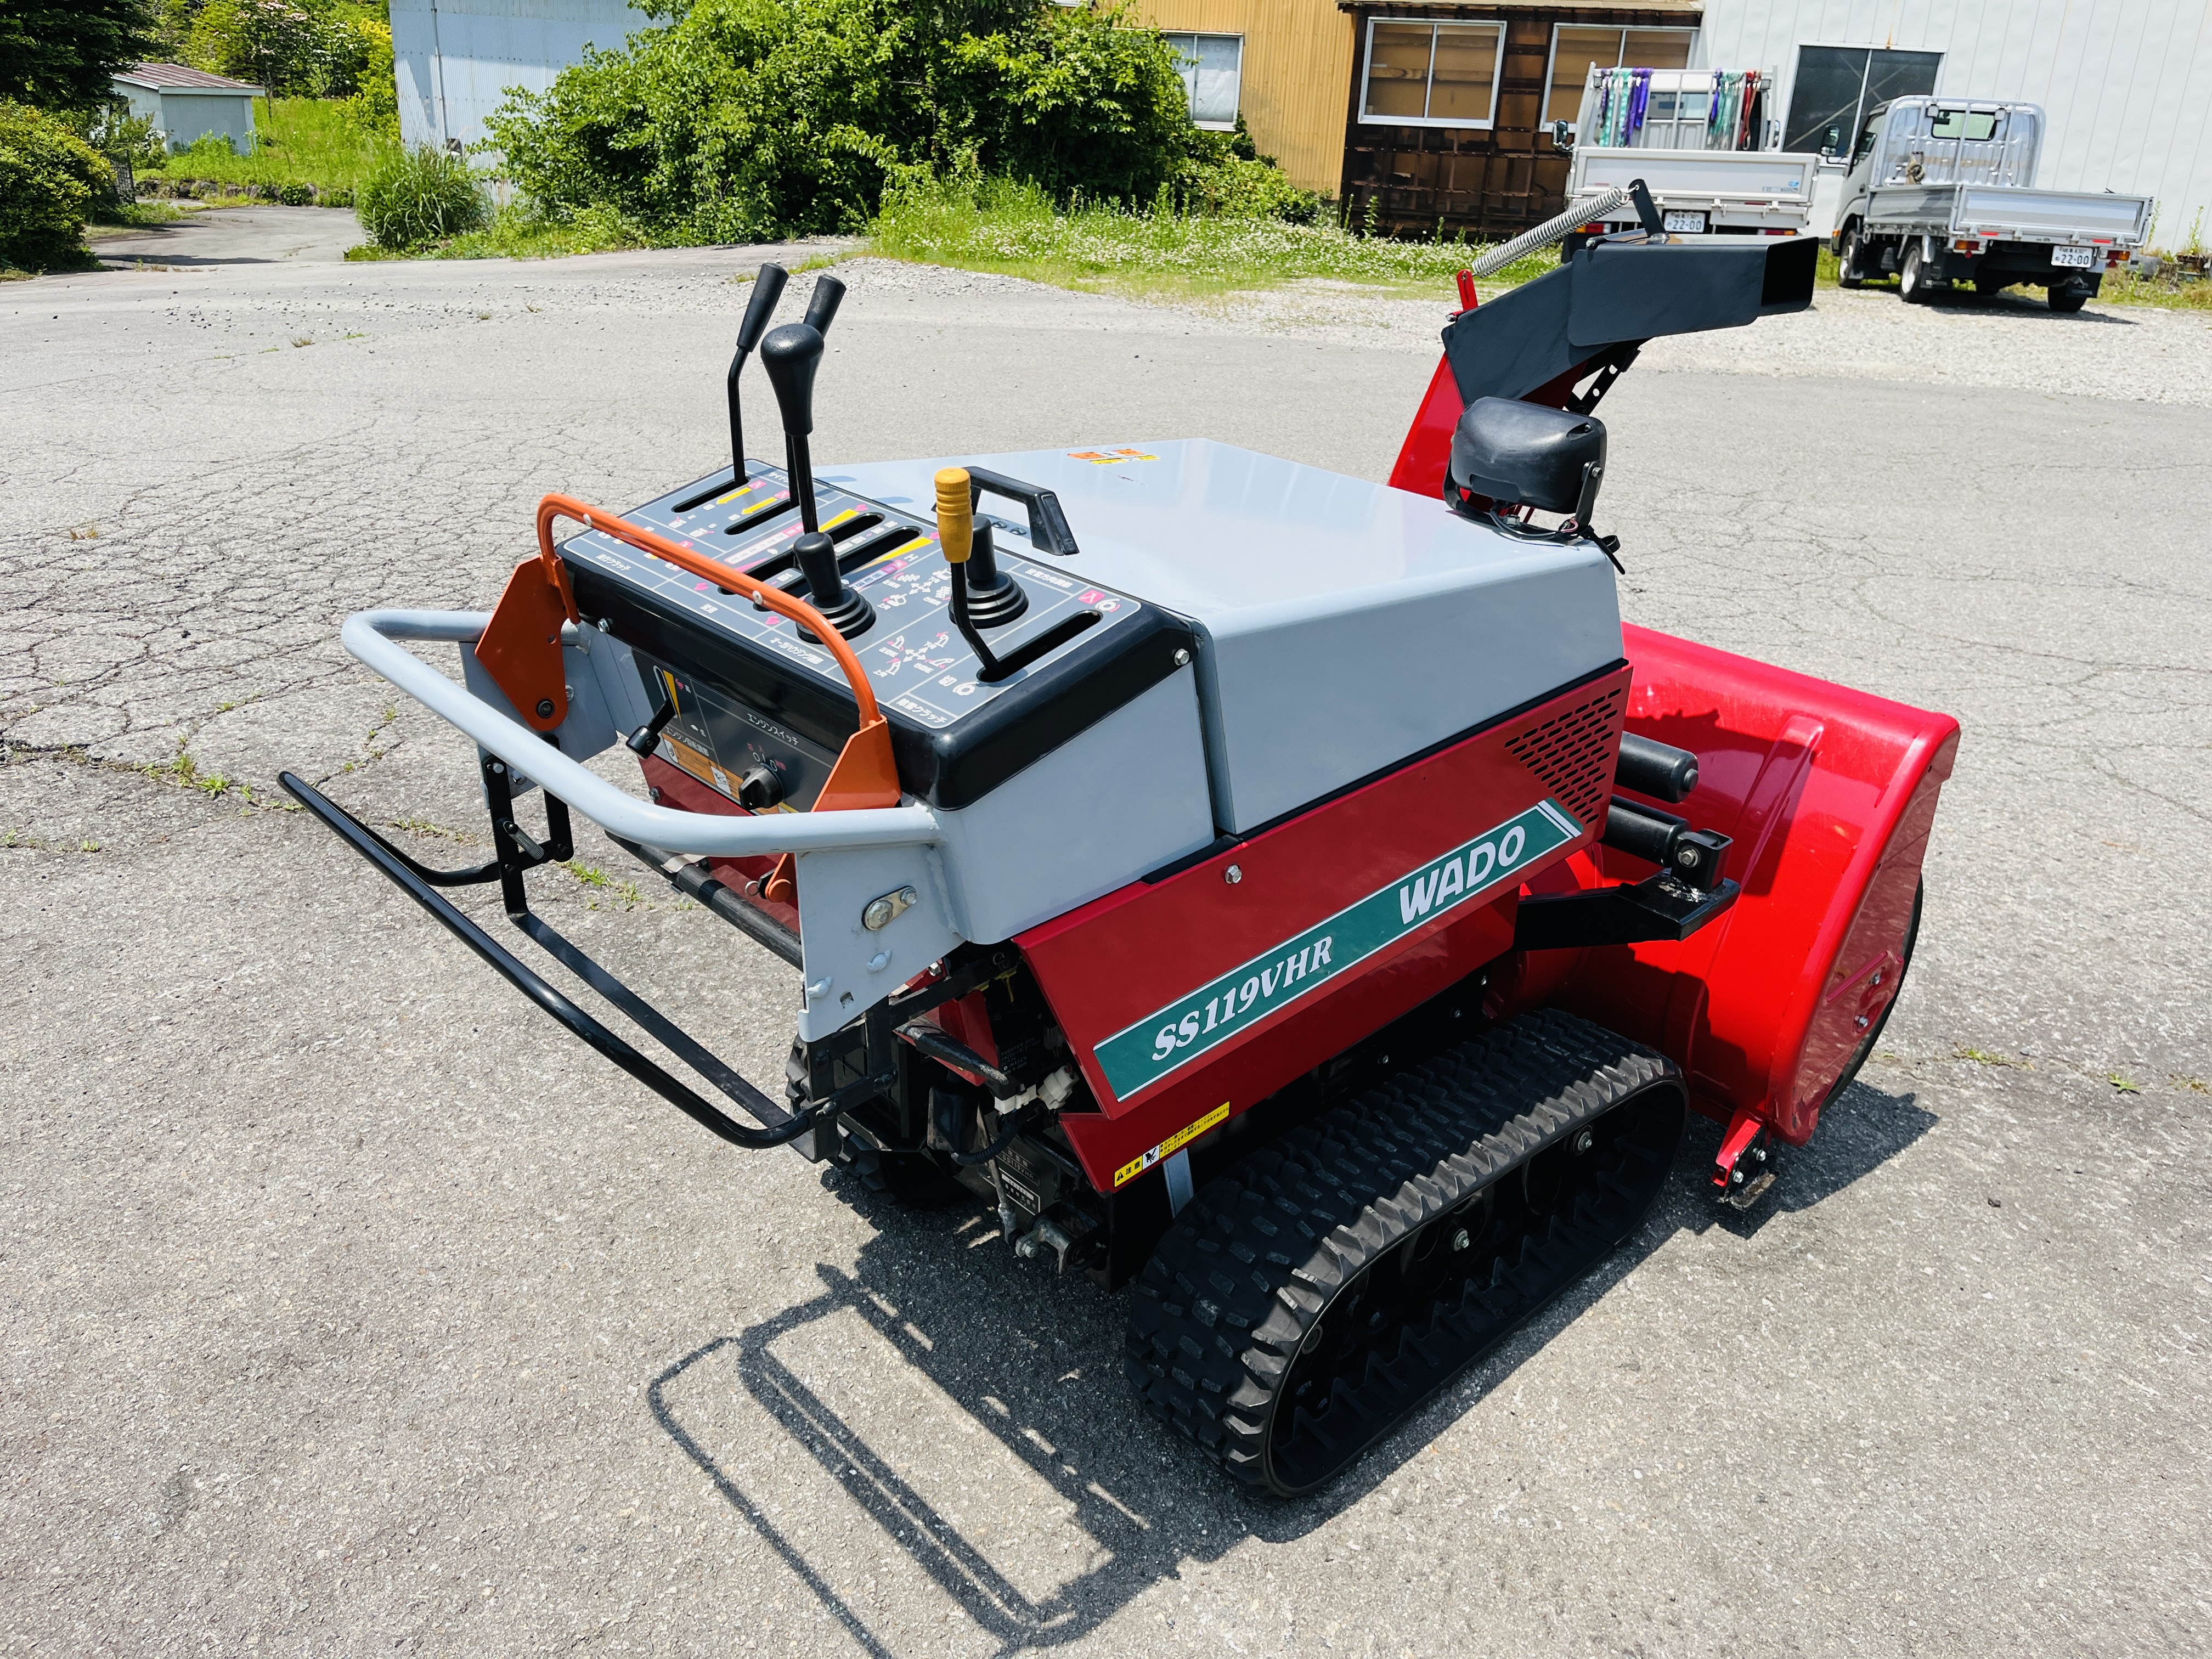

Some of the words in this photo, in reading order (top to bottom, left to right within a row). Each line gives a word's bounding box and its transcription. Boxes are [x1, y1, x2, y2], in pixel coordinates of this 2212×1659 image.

[1673, 219, 1702, 230] 22-00
[2061, 254, 2090, 265] 22-00
[747, 713, 799, 746] エンジンスイッチ
[1399, 825, 1526, 925] WADO
[1152, 935, 1332, 1062] SS119VHR
